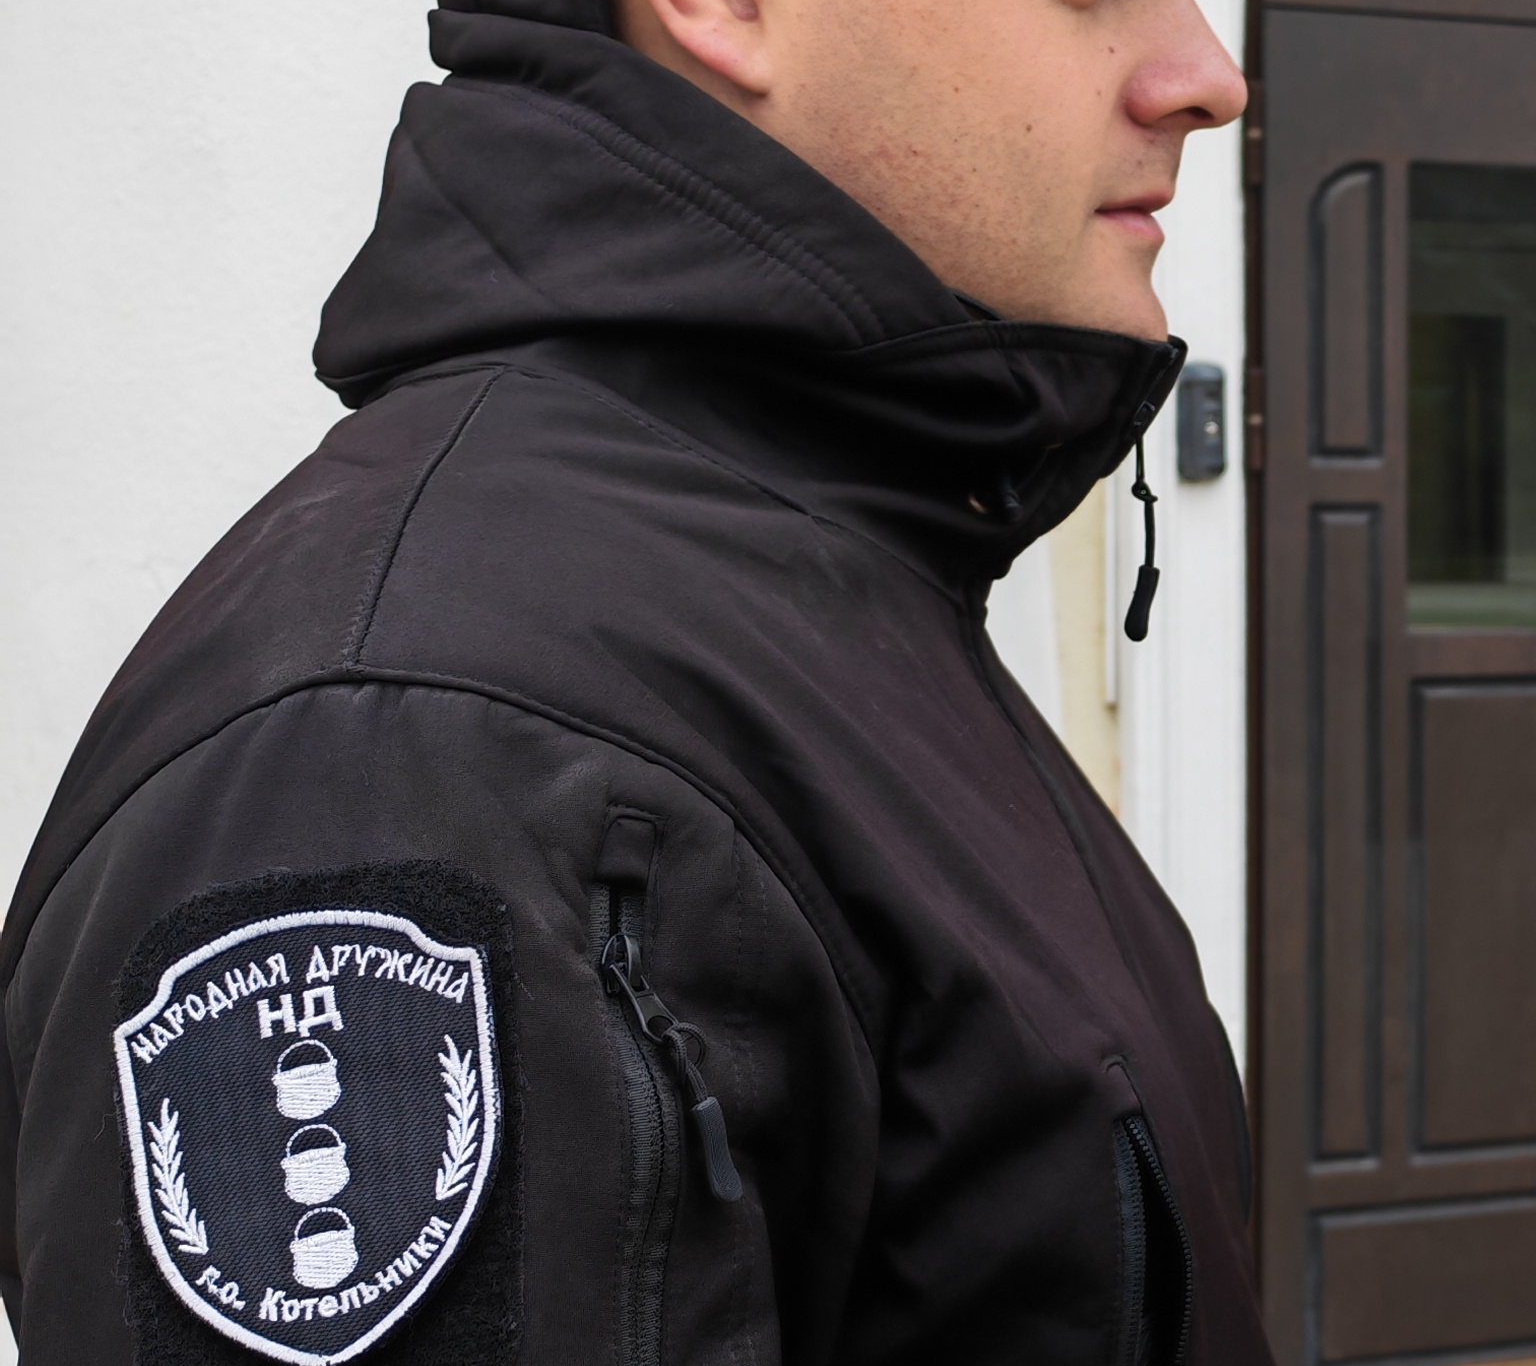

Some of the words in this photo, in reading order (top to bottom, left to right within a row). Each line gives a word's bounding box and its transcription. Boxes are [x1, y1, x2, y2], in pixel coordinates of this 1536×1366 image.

[131, 952, 291, 1064] НАРОДНАЯ
[306, 943, 470, 1004] ДРУЖИНА
[257, 985, 345, 1040] НД
[258, 1215, 453, 1323] Котельники
